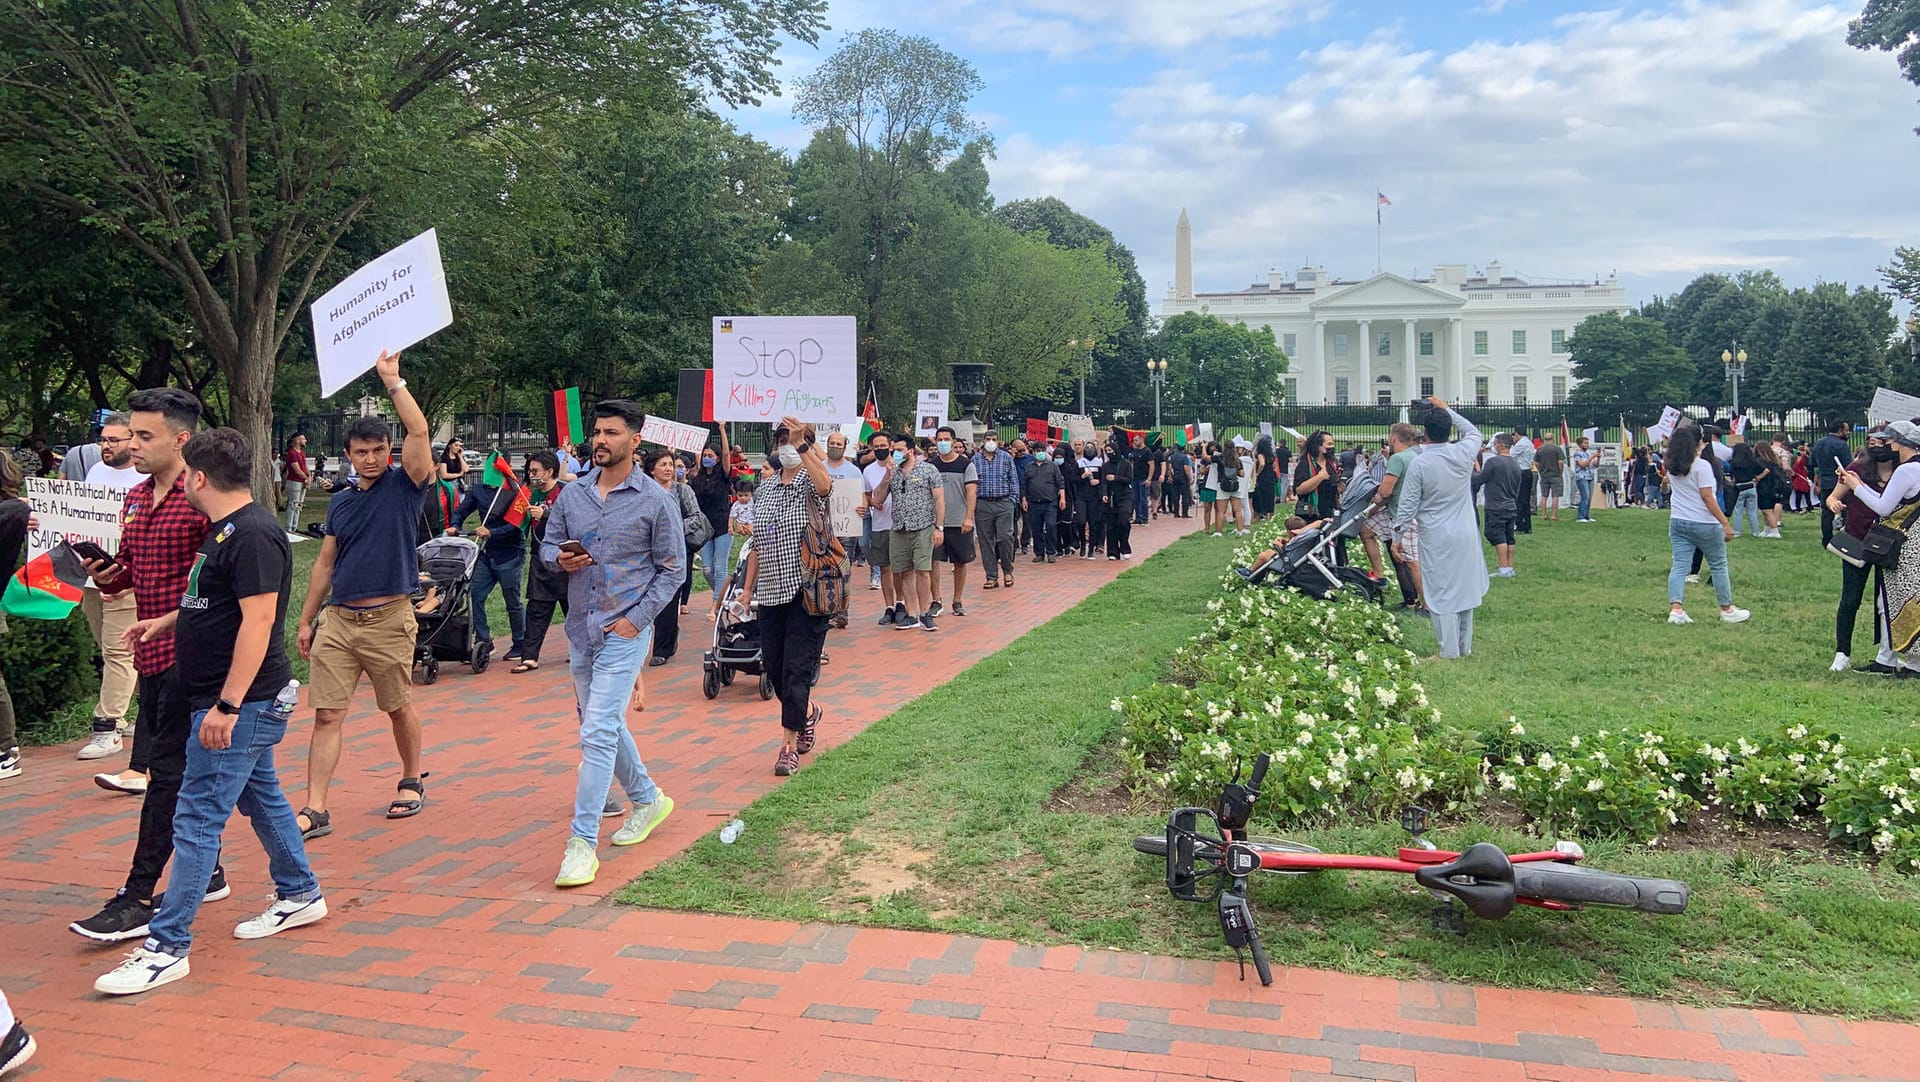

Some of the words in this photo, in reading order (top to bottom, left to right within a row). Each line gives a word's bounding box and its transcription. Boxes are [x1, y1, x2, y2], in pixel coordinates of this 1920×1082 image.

[329, 277, 388, 322] Humanity
[392, 264, 412, 281] for
[333, 284, 415, 345] Afghanistan!
[728, 377, 777, 416] Killing
[783, 388, 837, 415] Afghans
[48, 479, 65, 496] Not
[65, 481, 73, 496] A
[74, 482, 106, 500] Political
[107, 486, 128, 502] Mat
[50, 500, 59, 515] A
[61, 501, 117, 524] Humanitarian
